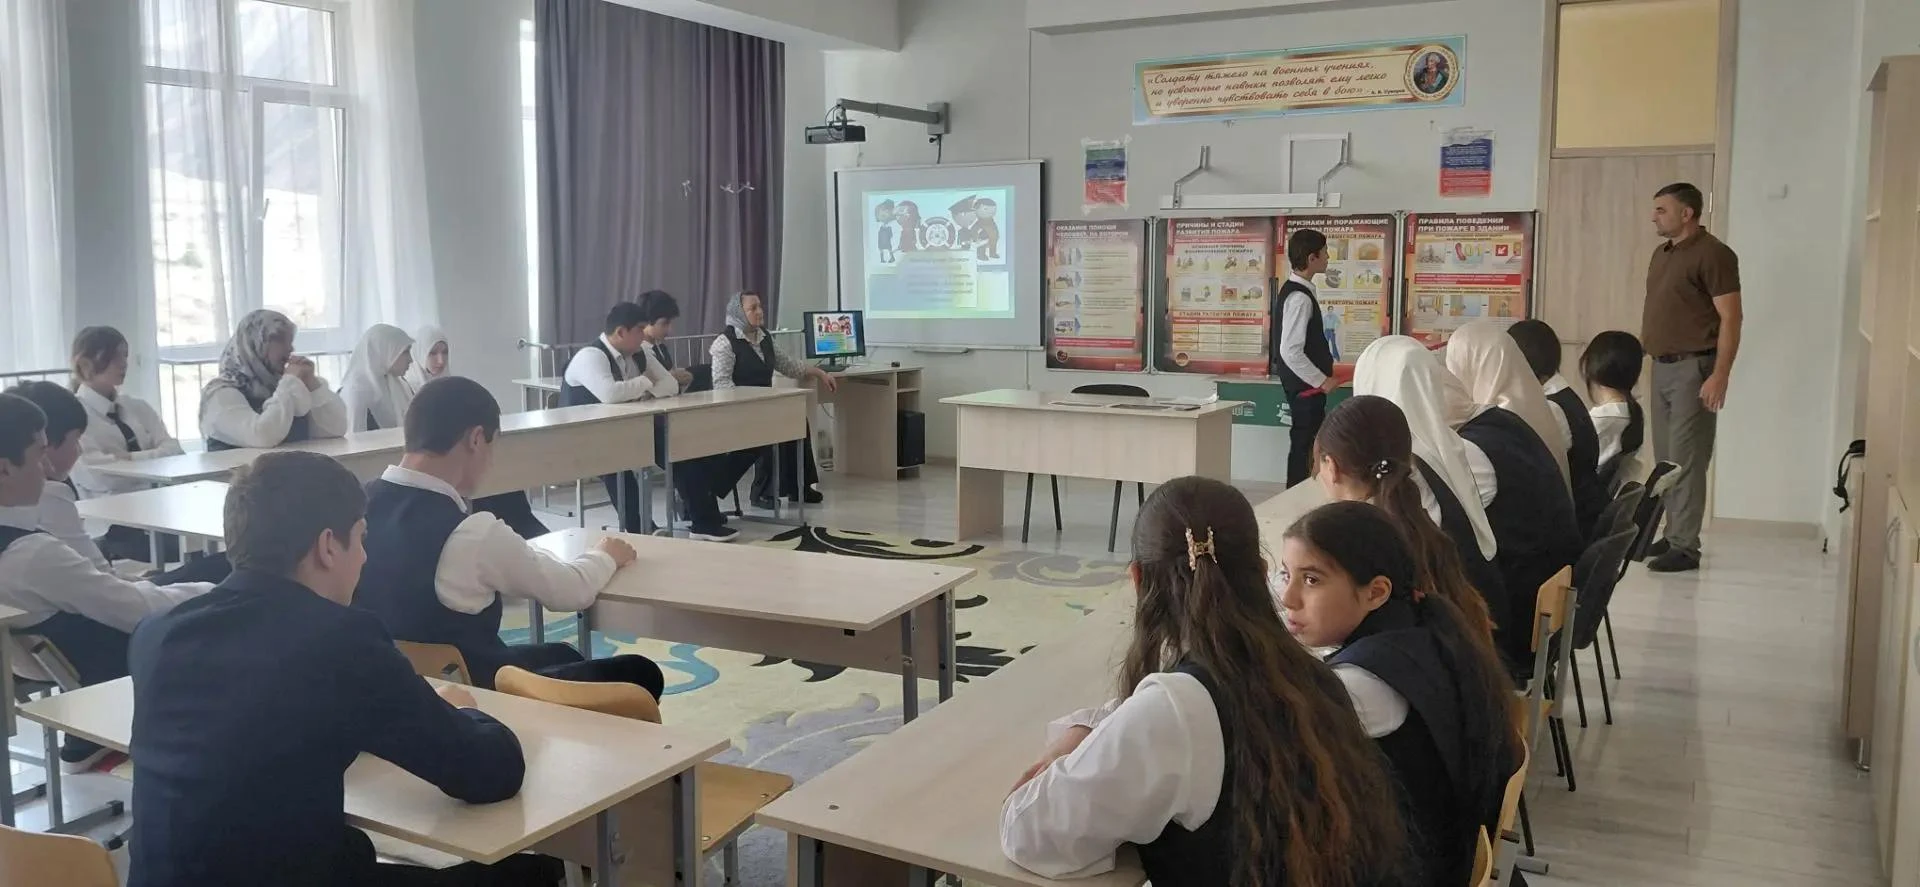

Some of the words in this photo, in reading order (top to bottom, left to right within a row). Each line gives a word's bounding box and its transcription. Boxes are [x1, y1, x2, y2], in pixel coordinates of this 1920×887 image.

[1204, 70, 1249, 81] тяжело
[1272, 65, 1320, 76] военных
[1150, 88, 1164, 96] но
[1167, 84, 1222, 97] усвоенные
[1224, 80, 1267, 91] навыки
[1271, 75, 1325, 88] позволят
[1330, 75, 1352, 84] ему
[1355, 72, 1388, 81] легко
[1166, 96, 1213, 108] уверенно
[1217, 92, 1289, 104] чувствовать
[1292, 88, 1318, 98] себя
[1322, 86, 1332, 96] в
